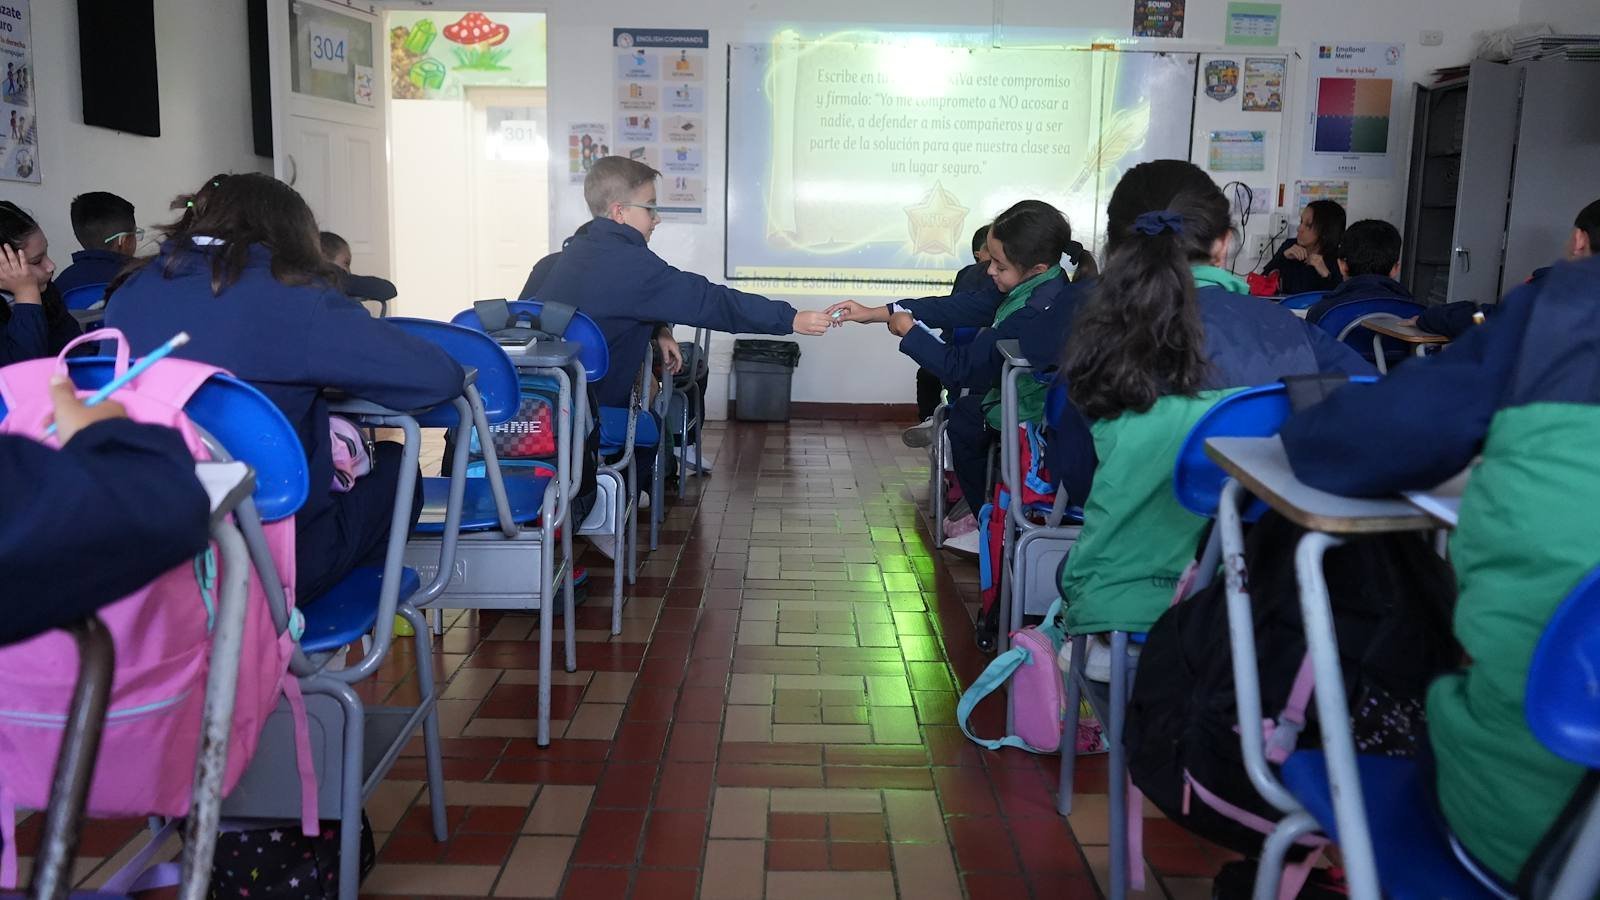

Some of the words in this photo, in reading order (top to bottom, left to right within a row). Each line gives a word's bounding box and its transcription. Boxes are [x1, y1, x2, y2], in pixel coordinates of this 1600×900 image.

[0, 5, 22, 20] zate
[1147, 1, 1171, 9] SOUND
[636, 35, 663, 43] ENGLISH
[664, 36, 704, 44] COMMANDS
[313, 35, 344, 63] 304
[1335, 45, 1367, 54] Emotional
[817, 69, 857, 85] Escribe
[860, 73, 874, 85] en
[976, 73, 999, 87] este
[1001, 72, 1071, 91] compromiso
[816, 95, 824, 109] y
[896, 95, 912, 107] me
[914, 93, 986, 111] comprometo
[988, 98, 997, 108] a
[998, 96, 1018, 109] NO
[1020, 98, 1059, 111] acosar
[1061, 99, 1070, 110] a
[505, 127, 532, 142] 301
[820, 115, 855, 130] nadie,
[857, 119, 866, 129] a
[868, 115, 918, 131] defender
[920, 120, 929, 131] a
[931, 117, 951, 131] mis
[953, 117, 1023, 135] compañeros
[1024, 122, 1033, 136] y
[1034, 121, 1043, 132] a
[1045, 121, 1063, 133] ser
[810, 136, 841, 153] parte
[842, 136, 857, 150] de
[859, 137, 871, 151] la
[872, 136, 919, 152] solución
[922, 141, 949, 156] para
[951, 142, 973, 157] que
[975, 140, 1018, 154] nuestra
[1020, 140, 1050, 155] clase
[1052, 144, 1071, 155] sea
[891, 161, 907, 174] un
[909, 158, 938, 177] lugar
[752, 270, 774, 290] hora
[783, 271, 797, 290] de
[802, 271, 848, 291] escribir
[867, 273, 942, 294] compromiso
